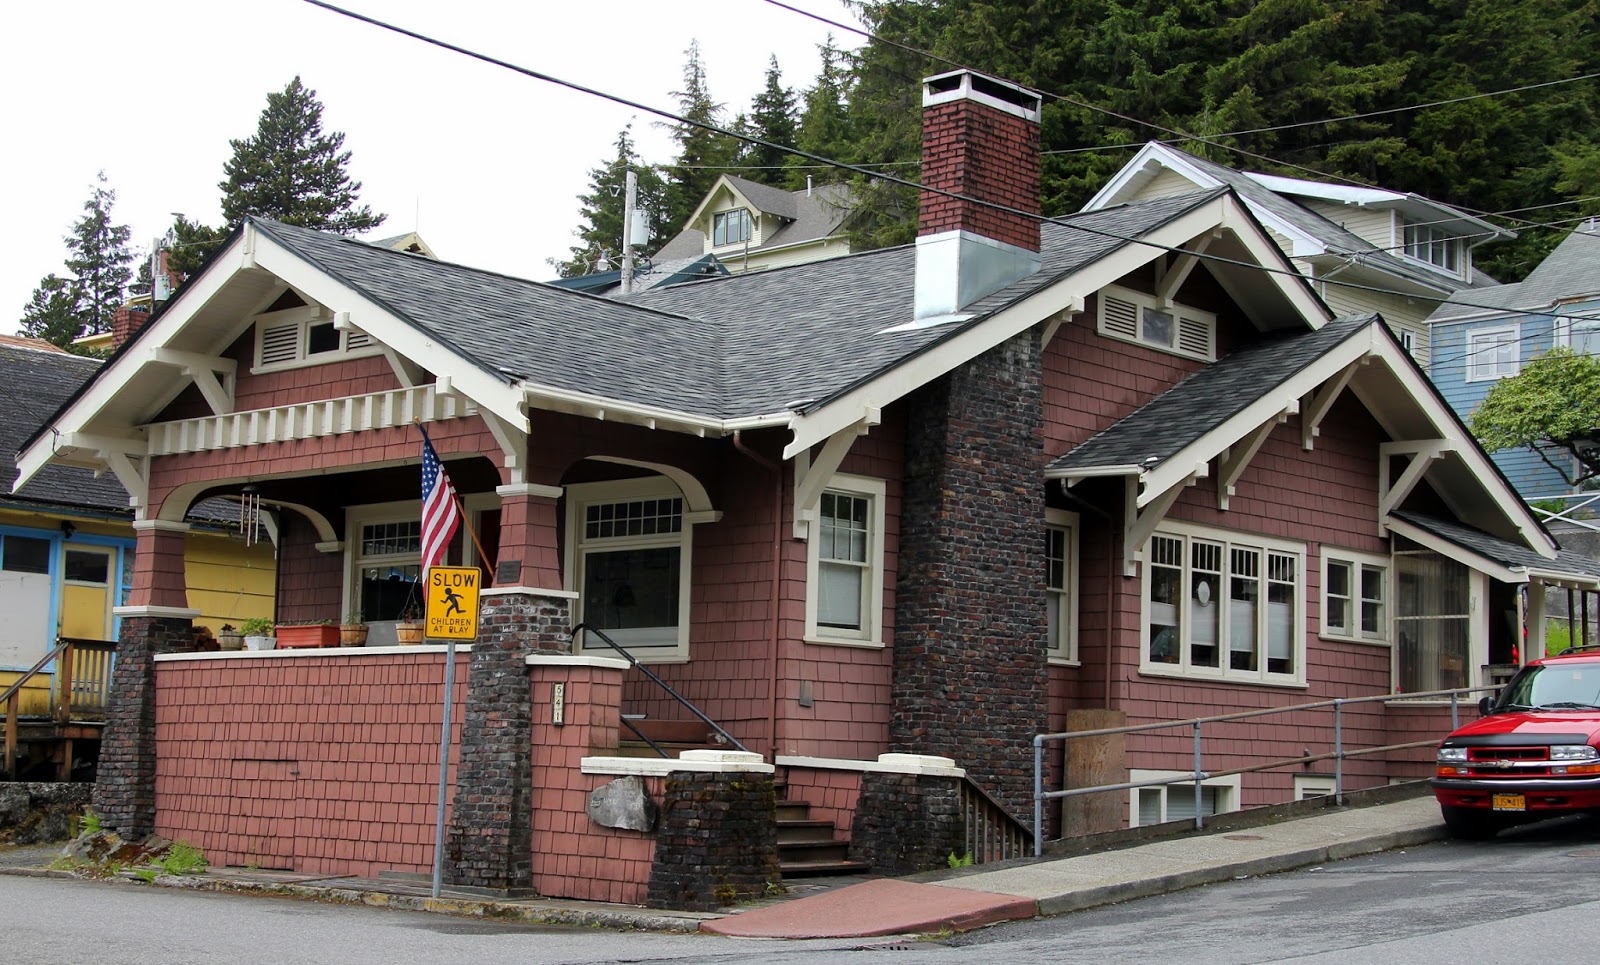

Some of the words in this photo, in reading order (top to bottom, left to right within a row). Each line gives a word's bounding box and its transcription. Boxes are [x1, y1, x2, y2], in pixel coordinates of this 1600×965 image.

[433, 573, 475, 587] SLOW
[431, 617, 471, 626] CHILDREN
[449, 626, 469, 634] PLAY
